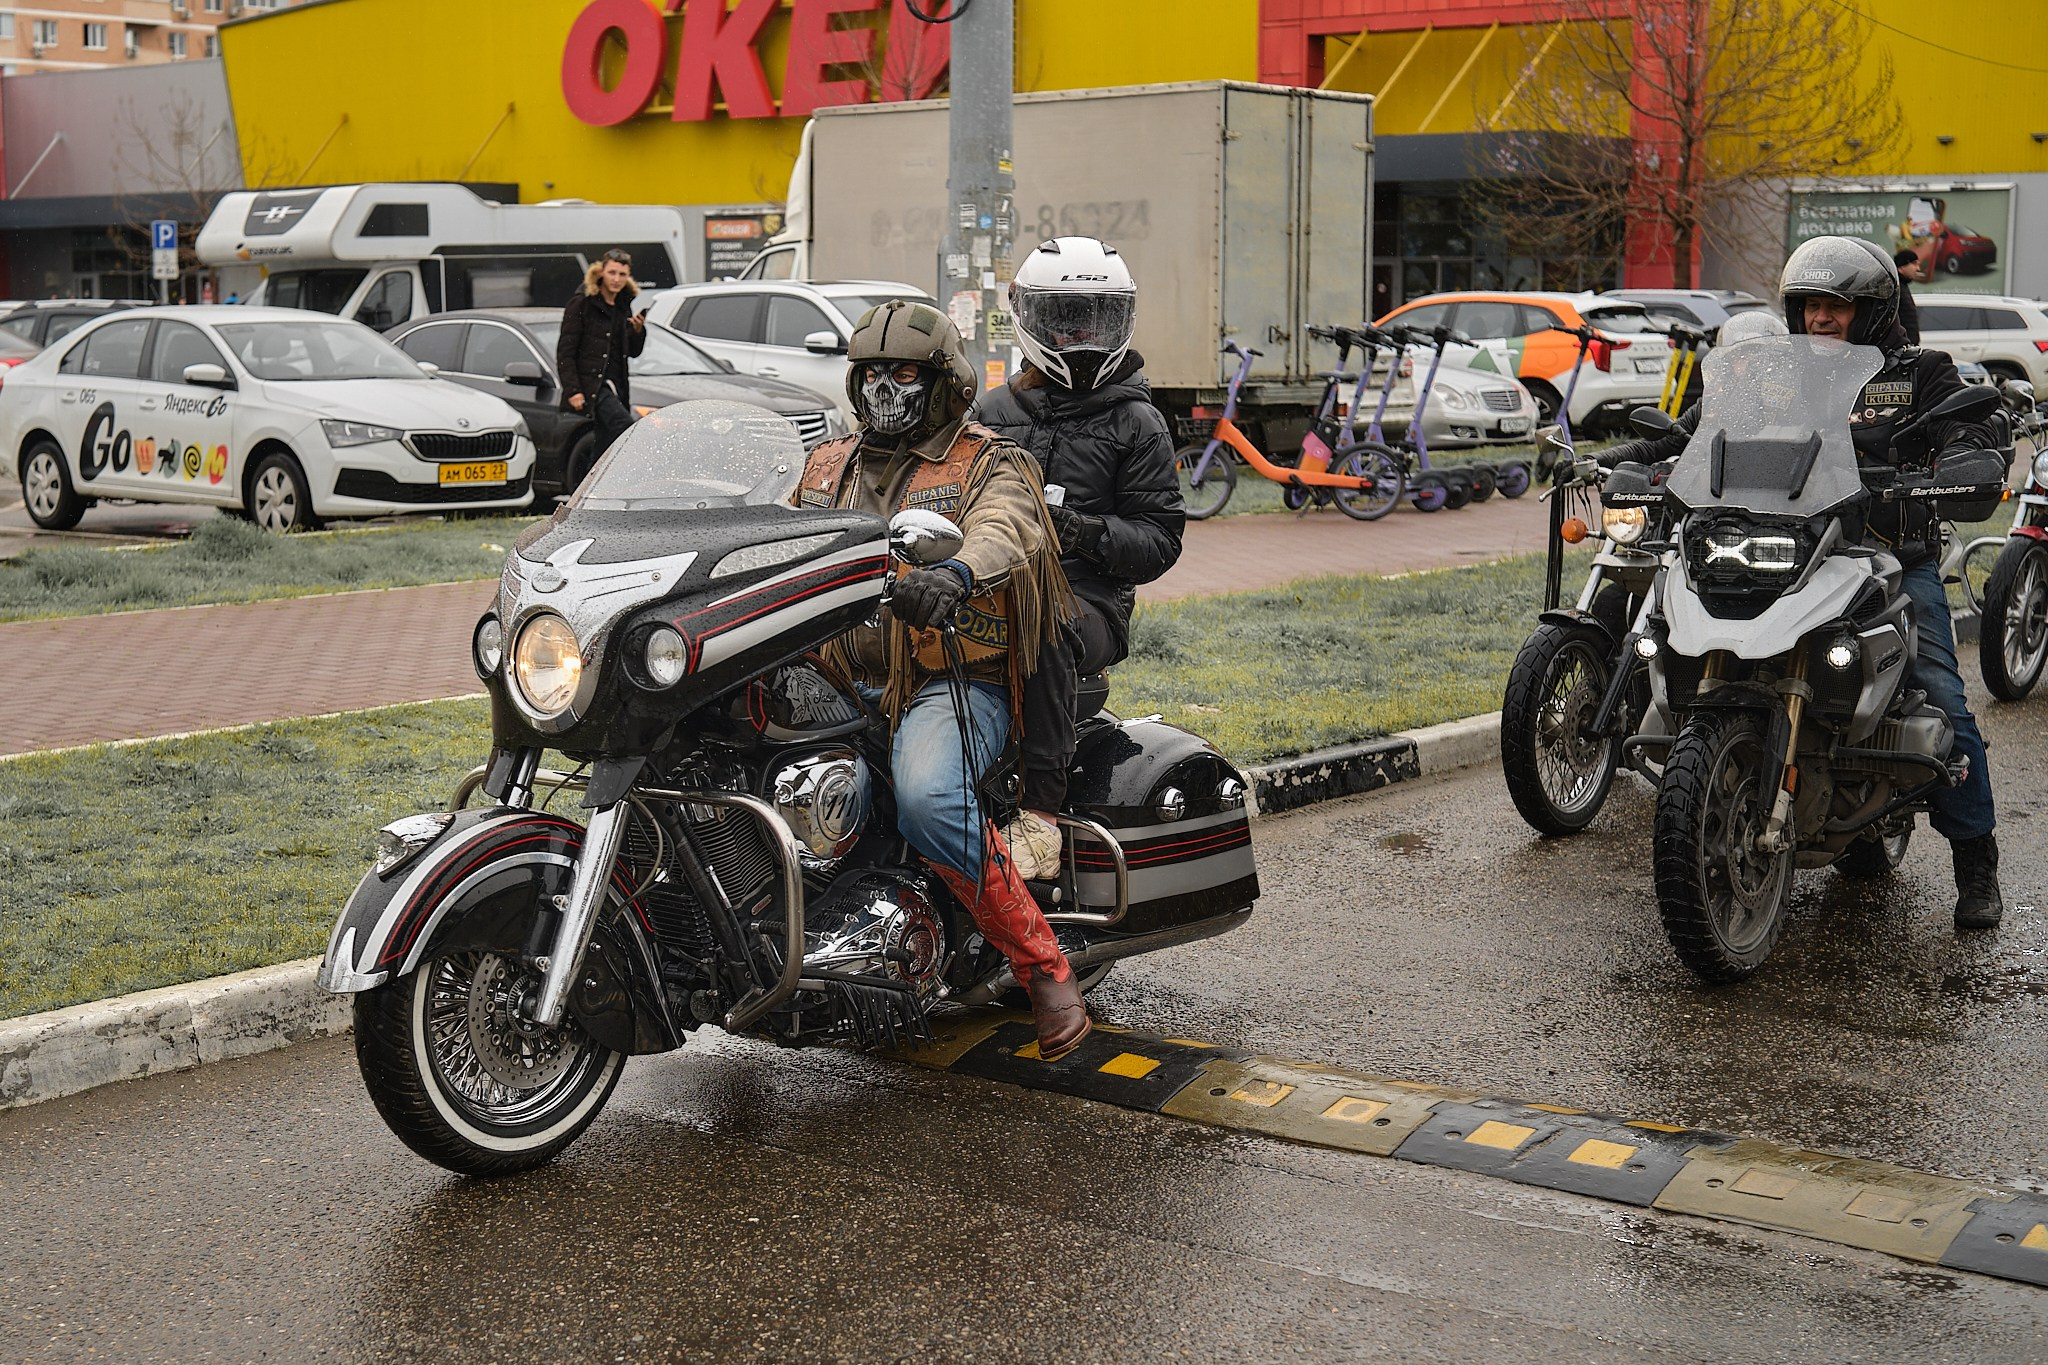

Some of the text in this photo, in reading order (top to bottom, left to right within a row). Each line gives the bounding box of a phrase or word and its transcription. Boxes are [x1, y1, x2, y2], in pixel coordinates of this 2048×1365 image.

[1797, 222, 1873, 236] доставка
[1060, 274, 1108, 282] LS2
[1804, 270, 1830, 279] SHOEI
[1868, 383, 1910, 392] GIPANIS
[164, 393, 227, 418] Яндекс Go
[1869, 394, 1908, 403] KUBAN
[79, 401, 132, 481] Go
[464, 465, 487, 480] 065
[909, 484, 958, 502] GIPANIS
[1910, 480, 1977, 496] Barkbusters
[1611, 492, 1664, 502] Barkbusters
[824, 791, 857, 820] 111
